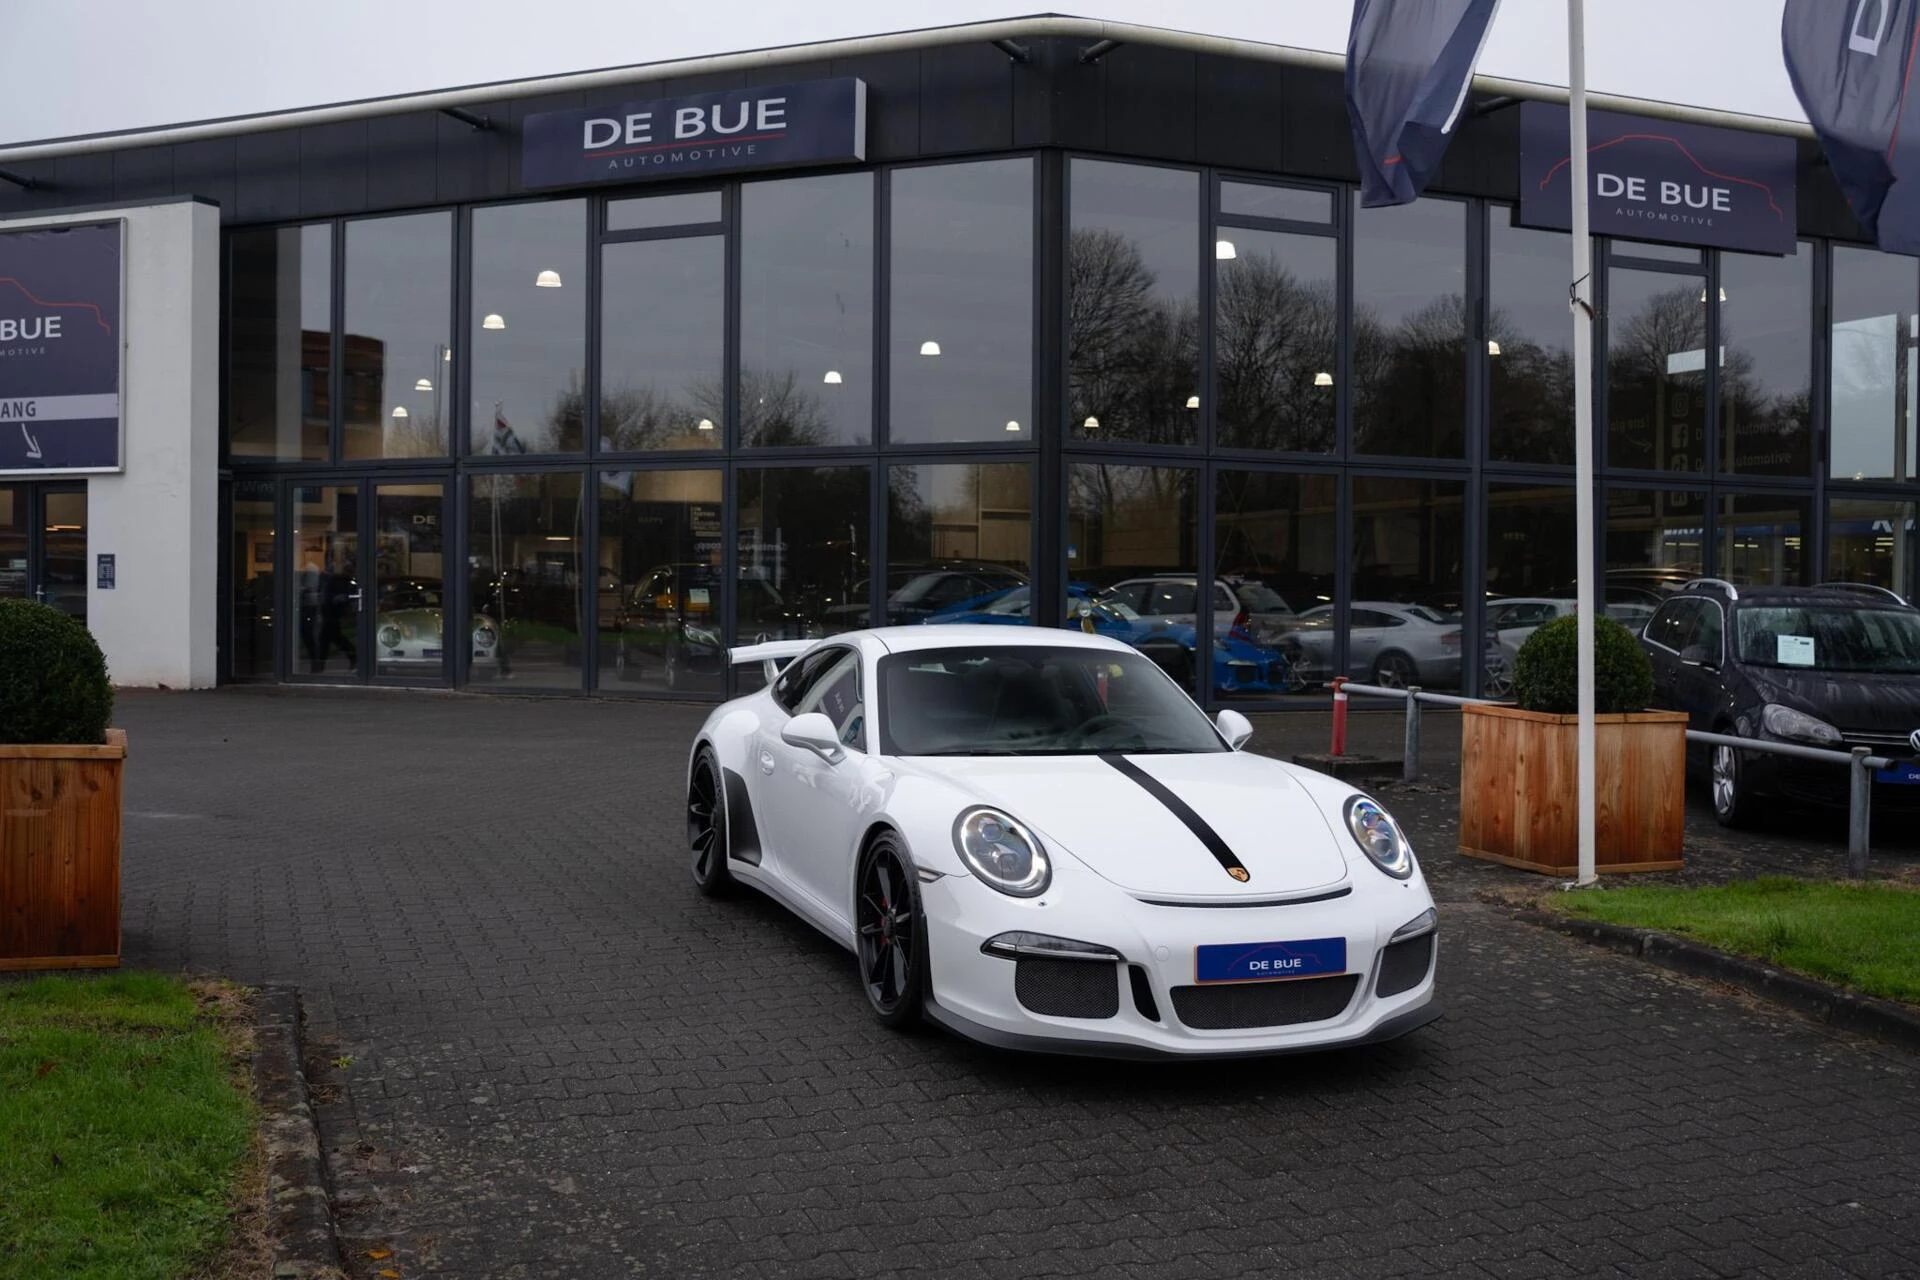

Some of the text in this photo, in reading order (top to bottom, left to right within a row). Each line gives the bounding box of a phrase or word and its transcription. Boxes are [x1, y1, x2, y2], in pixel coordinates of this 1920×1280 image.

[583, 97, 787, 150] DE BUE
[608, 144, 757, 169] AUTOMOTIVE
[1597, 172, 1731, 212] DE BUE
[1615, 207, 1713, 226] AUTOMOTIVE
[0, 316, 62, 341] BUE
[1, 401, 36, 417] ANG
[412, 514, 437, 525] DE
[1249, 958, 1302, 971] DE BUE
